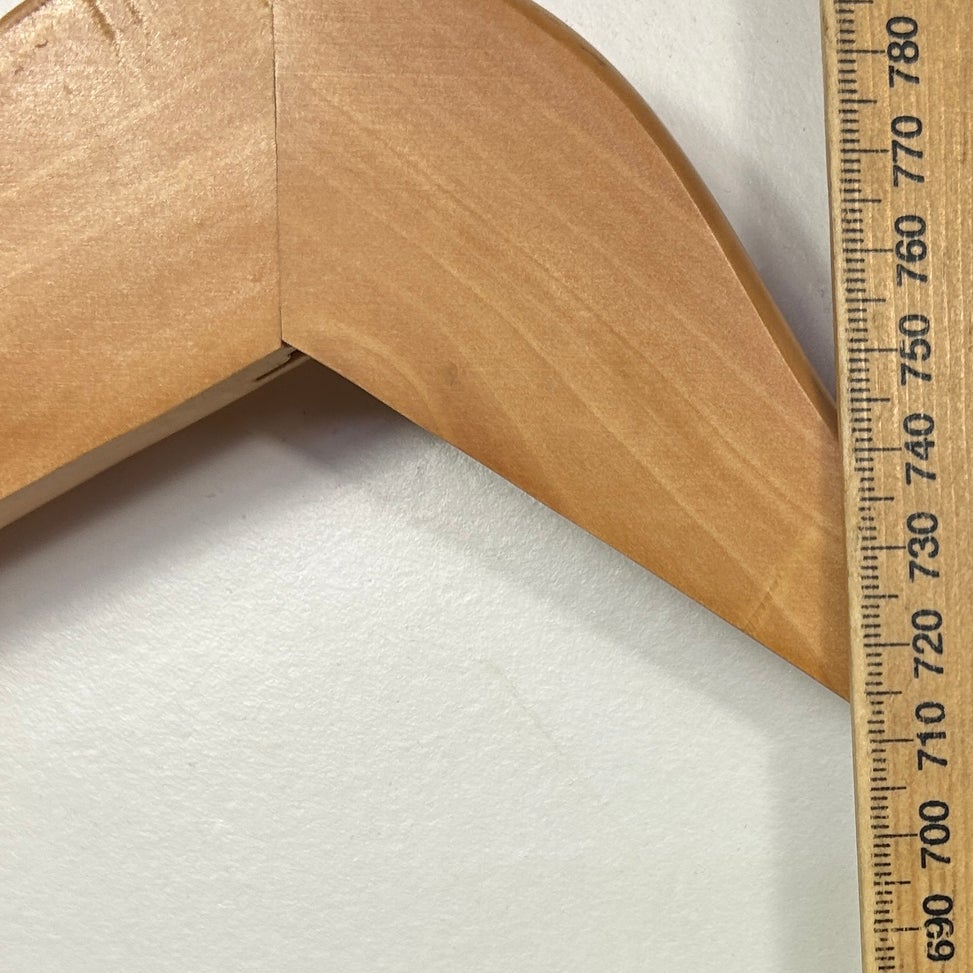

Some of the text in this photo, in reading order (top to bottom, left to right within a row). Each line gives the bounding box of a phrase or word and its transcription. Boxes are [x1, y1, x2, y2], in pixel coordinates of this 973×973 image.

[885, 15, 920, 88] 780
[890, 115, 925, 188] 770
[894, 214, 928, 287] 760
[898, 314, 932, 386] 750
[902, 413, 937, 486] 740
[906, 511, 940, 583] 730
[911, 609, 944, 679] 720
[914, 701, 948, 771] 710
[918, 800, 951, 869] 700
[922, 893, 956, 962] 690
